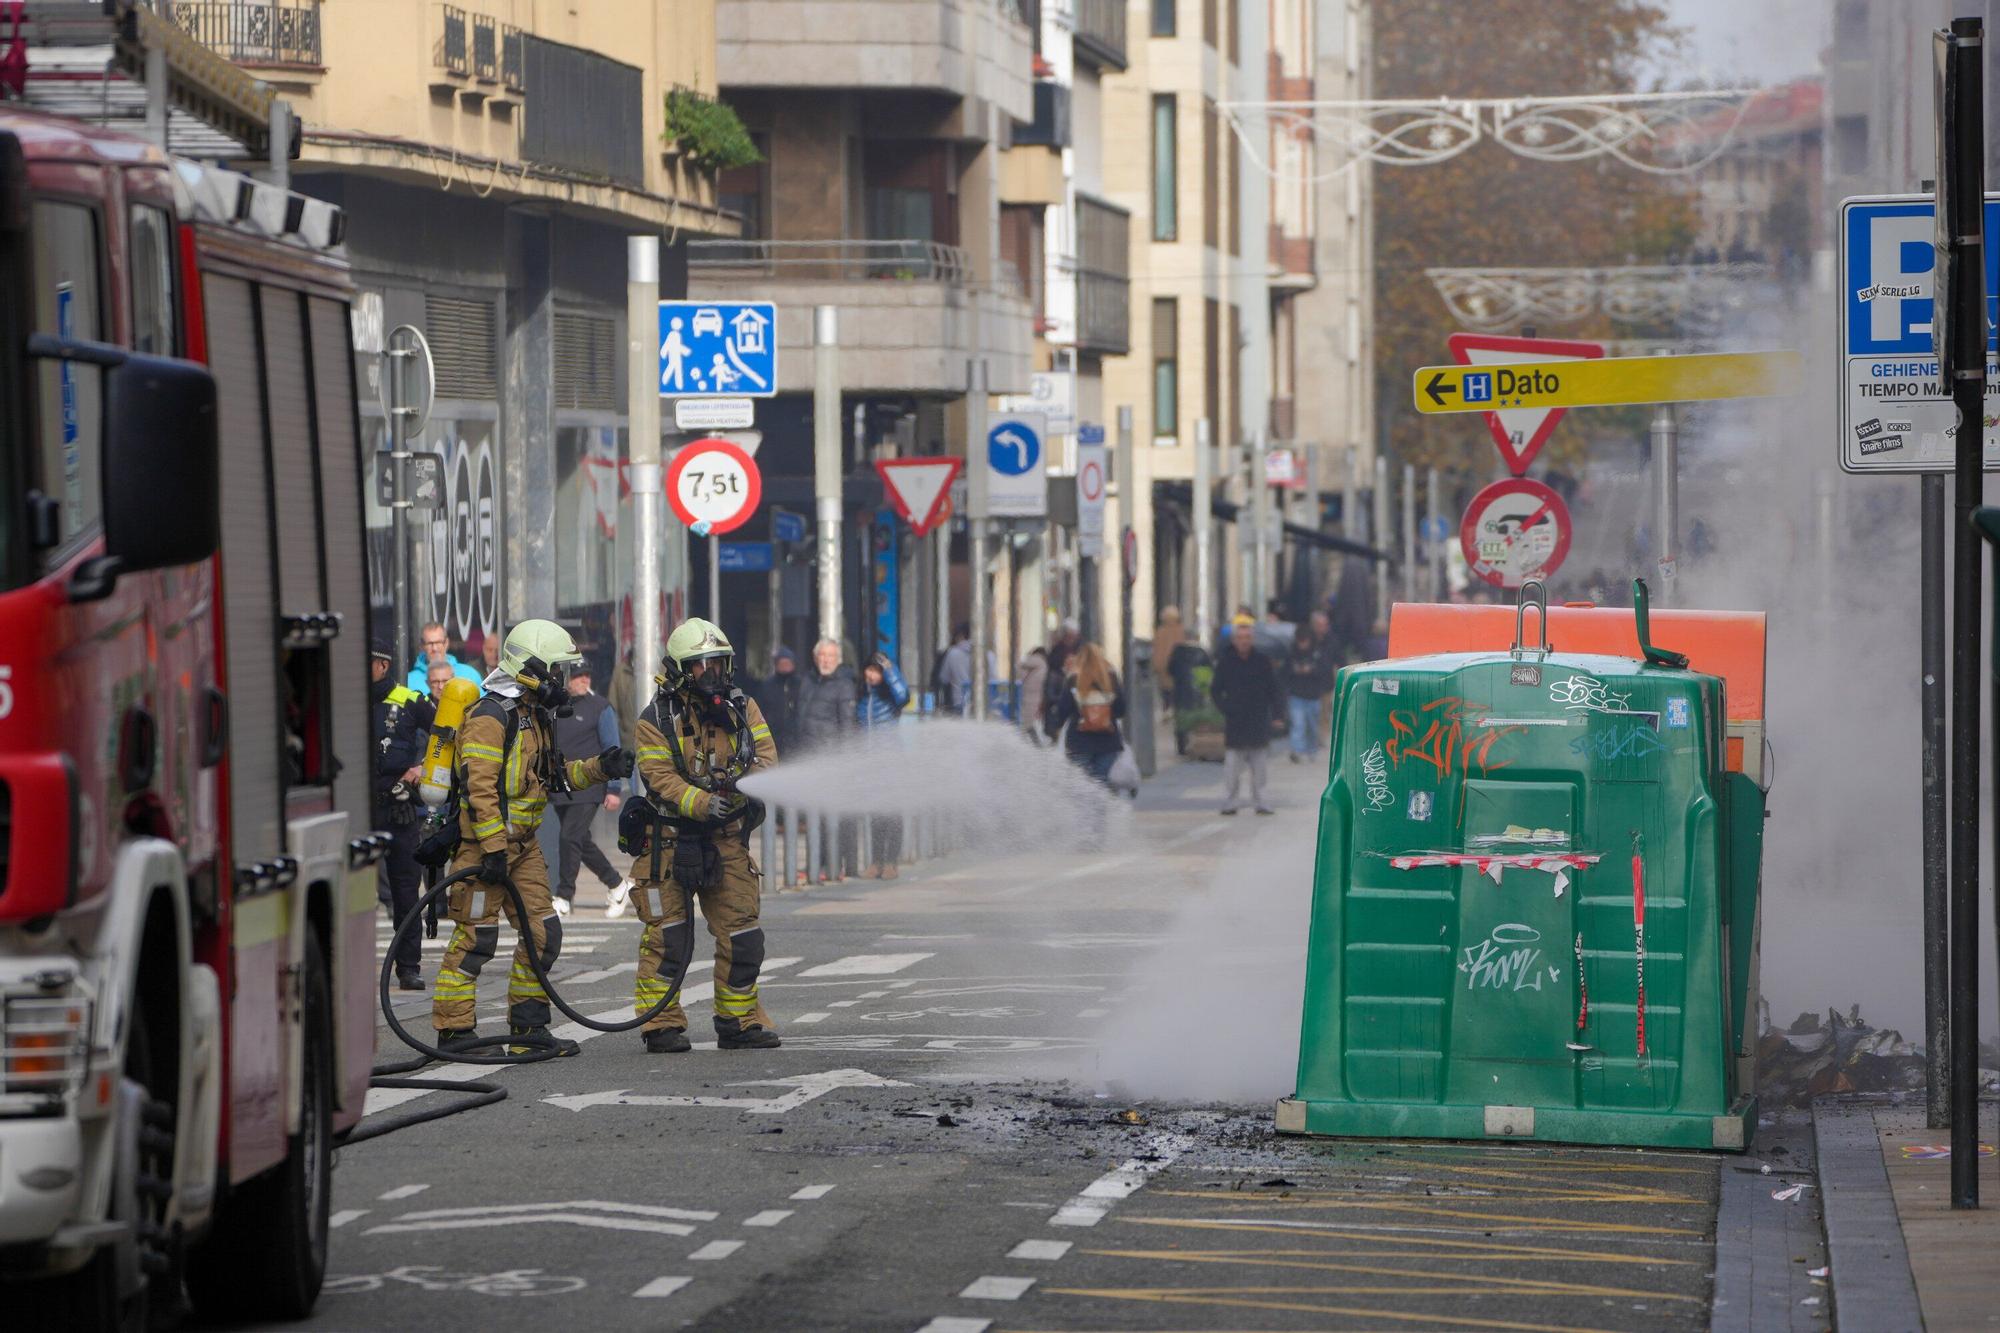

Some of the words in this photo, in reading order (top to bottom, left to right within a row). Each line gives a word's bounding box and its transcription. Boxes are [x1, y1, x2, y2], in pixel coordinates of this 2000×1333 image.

[1871, 363, 1939, 377] GEHIENE
[1497, 369, 1559, 396] Dato
[1859, 383, 1919, 397] TIEMPO
[687, 471, 738, 503] 7,5t
